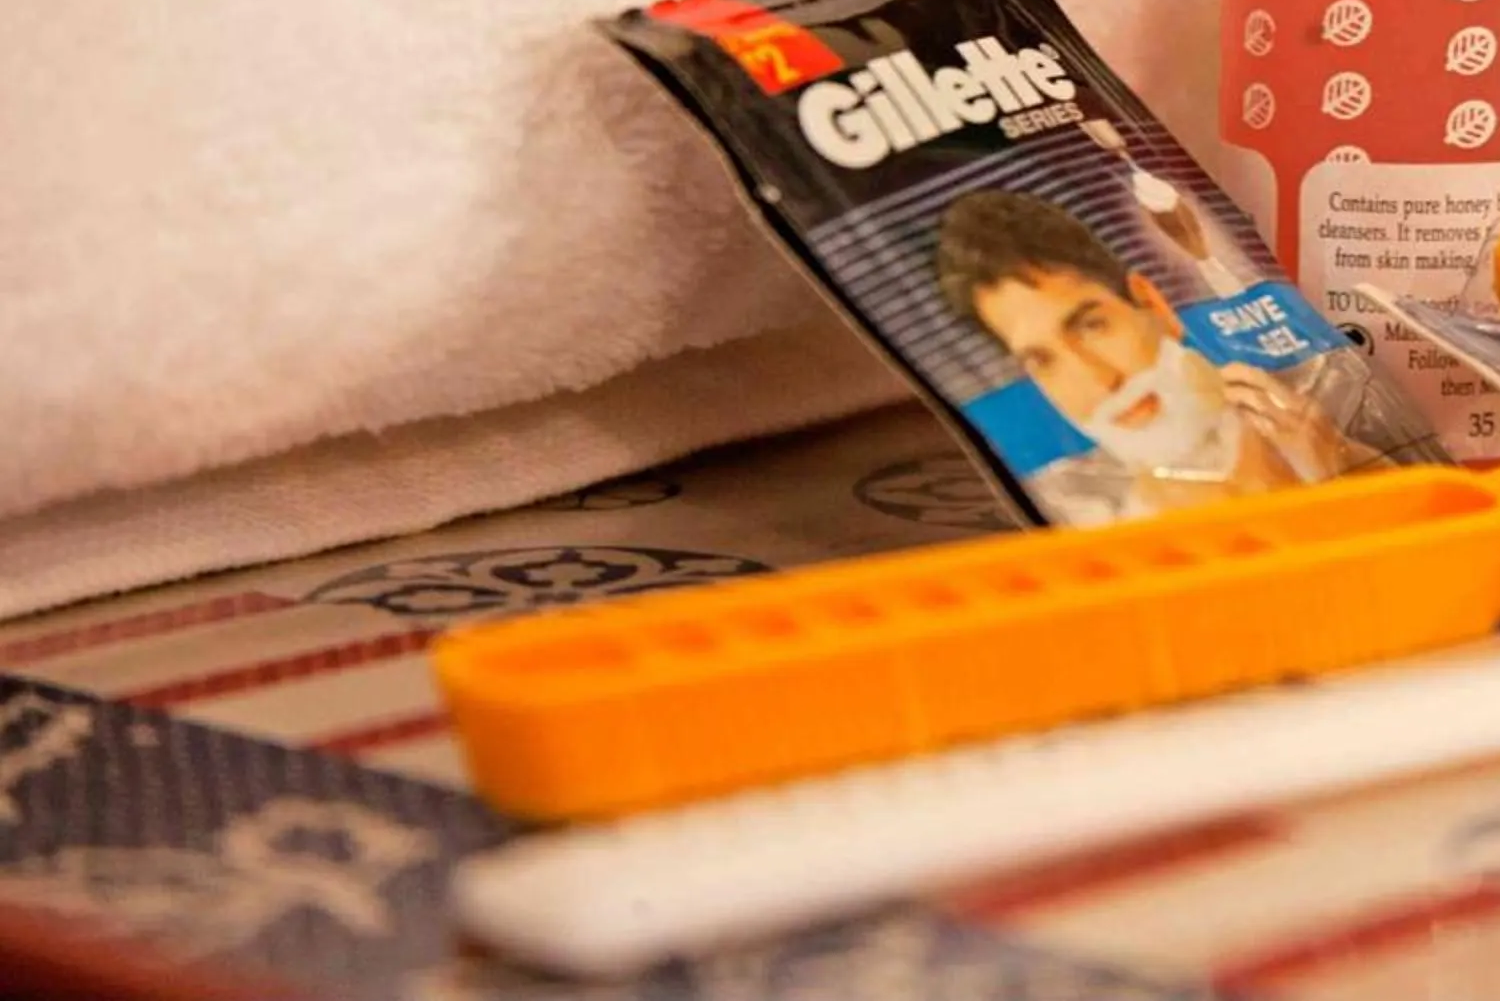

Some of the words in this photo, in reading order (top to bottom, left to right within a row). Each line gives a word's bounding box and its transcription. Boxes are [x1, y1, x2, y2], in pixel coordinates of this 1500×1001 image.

[797, 36, 1076, 169] Gillette
[999, 102, 1085, 140] SERIES
[1328, 191, 1398, 214] Contains
[1403, 198, 1440, 220] pure
[1445, 194, 1491, 219] honey
[1318, 219, 1391, 241] cleansers.
[1397, 222, 1410, 241] It
[1415, 227, 1481, 242] removes
[1335, 247, 1372, 268] from
[1376, 249, 1410, 270] skin
[1327, 290, 1350, 312] TO
[1209, 295, 1287, 336] SHAVE
[1440, 379, 1473, 396] then
[1468, 412, 1496, 438] 35
